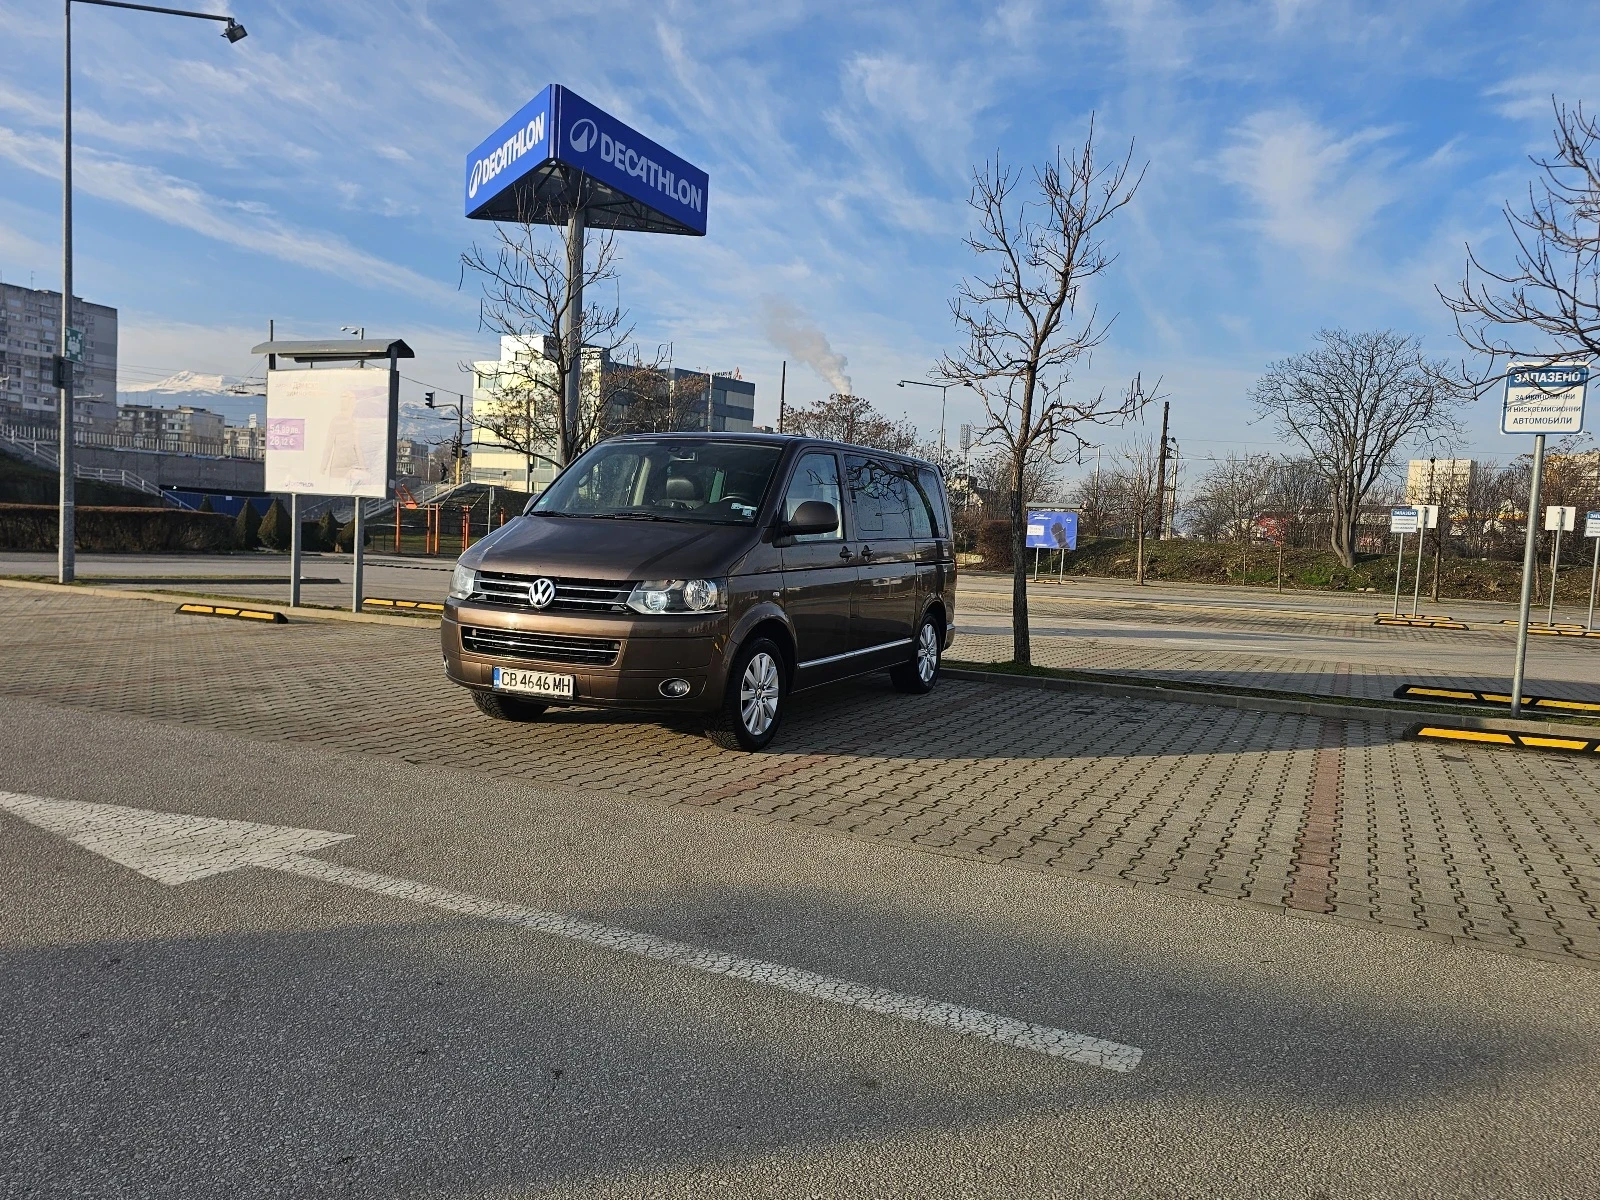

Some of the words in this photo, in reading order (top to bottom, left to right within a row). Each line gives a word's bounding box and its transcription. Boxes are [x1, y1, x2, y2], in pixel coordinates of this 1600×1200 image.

[482, 112, 545, 185] DECATHLON
[600, 132, 702, 213] DECATHLON
[1514, 371, 1581, 383] ЗАПАЗЕНО
[1512, 417, 1573, 425] АВТОМОБИЛИ
[501, 671, 518, 687] CB
[520, 673, 551, 691] 4646
[552, 676, 571, 693] MH
